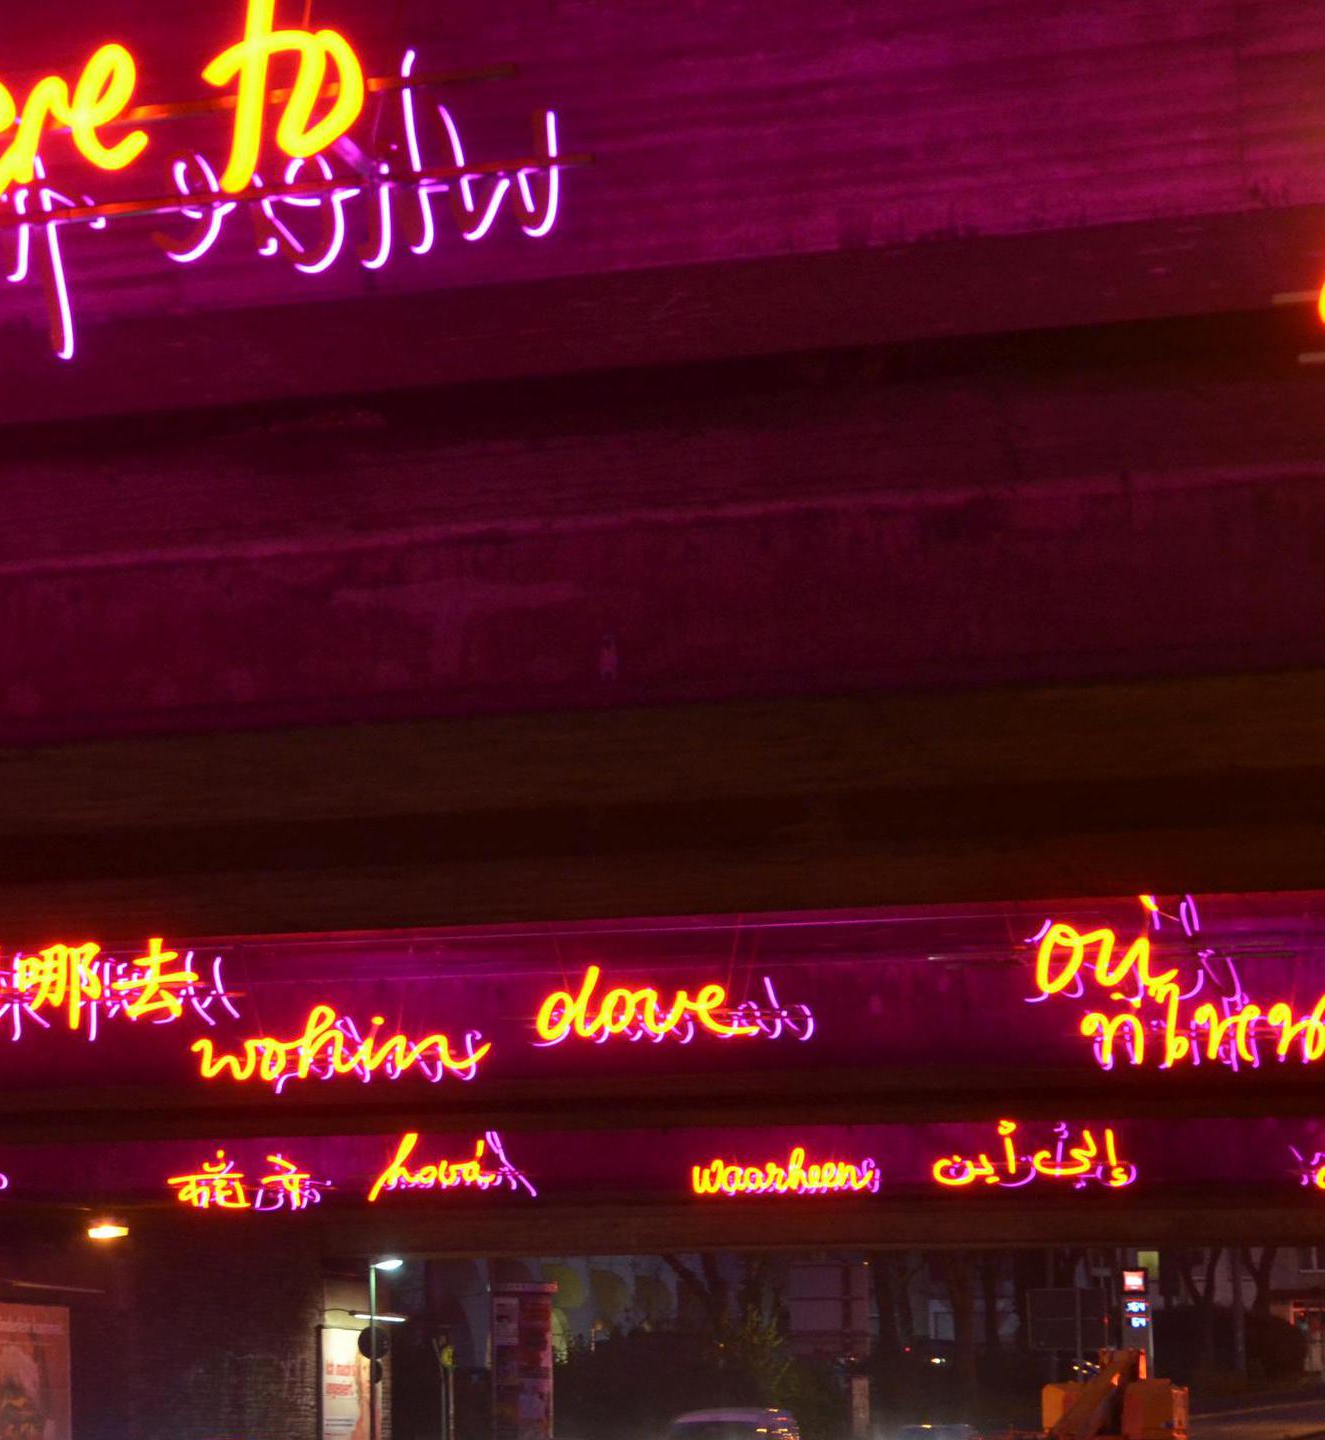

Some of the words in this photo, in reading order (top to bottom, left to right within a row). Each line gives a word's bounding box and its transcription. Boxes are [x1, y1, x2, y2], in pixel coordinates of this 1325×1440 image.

[201, 0, 365, 193] to
[536, 965, 761, 1042] dove
[191, 1005, 492, 1082] wohin
[692, 1147, 875, 1195] waarheen
